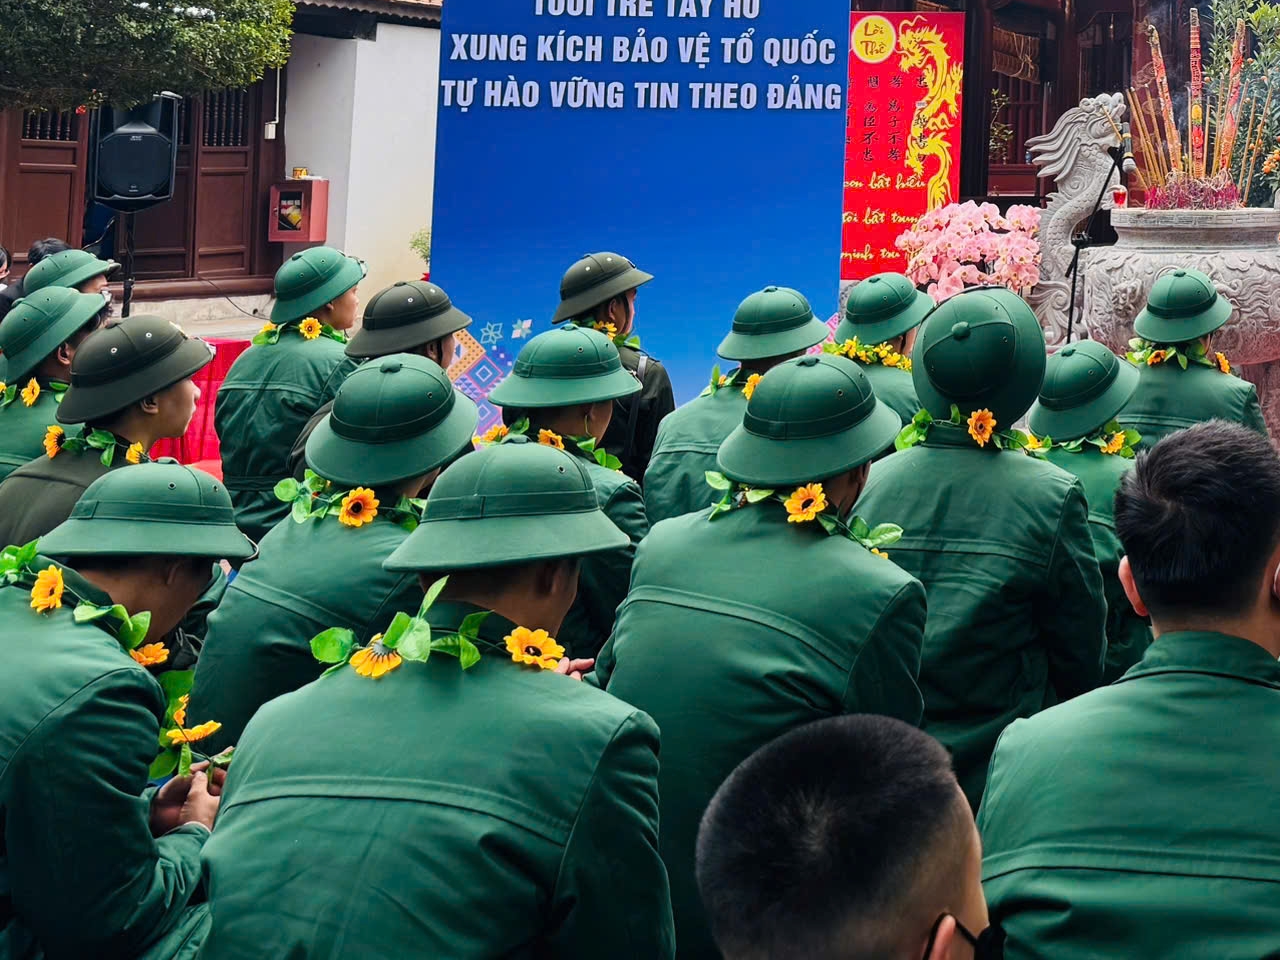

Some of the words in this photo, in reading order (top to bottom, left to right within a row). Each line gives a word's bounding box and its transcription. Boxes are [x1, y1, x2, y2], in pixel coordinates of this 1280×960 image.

[864, 22, 884, 36] Lời
[451, 34, 526, 60] XUNG
[538, 30, 602, 61] KÍCH
[613, 28, 667, 62] BẢO
[679, 32, 710, 68] VỆ
[721, 28, 754, 63] TỔ
[764, 30, 835, 66] QUỐC
[861, 41, 887, 55] Thề
[441, 78, 477, 111] TỰ
[485, 76, 539, 107] HÀO
[551, 77, 623, 107] VỮNG
[635, 83, 678, 107] TIN
[690, 83, 756, 108] THEO
[767, 75, 840, 109] ĐẢNG
[869, 171, 891, 189] bất
[895, 173, 925, 189] hiếu
[863, 207, 885, 224] bất
